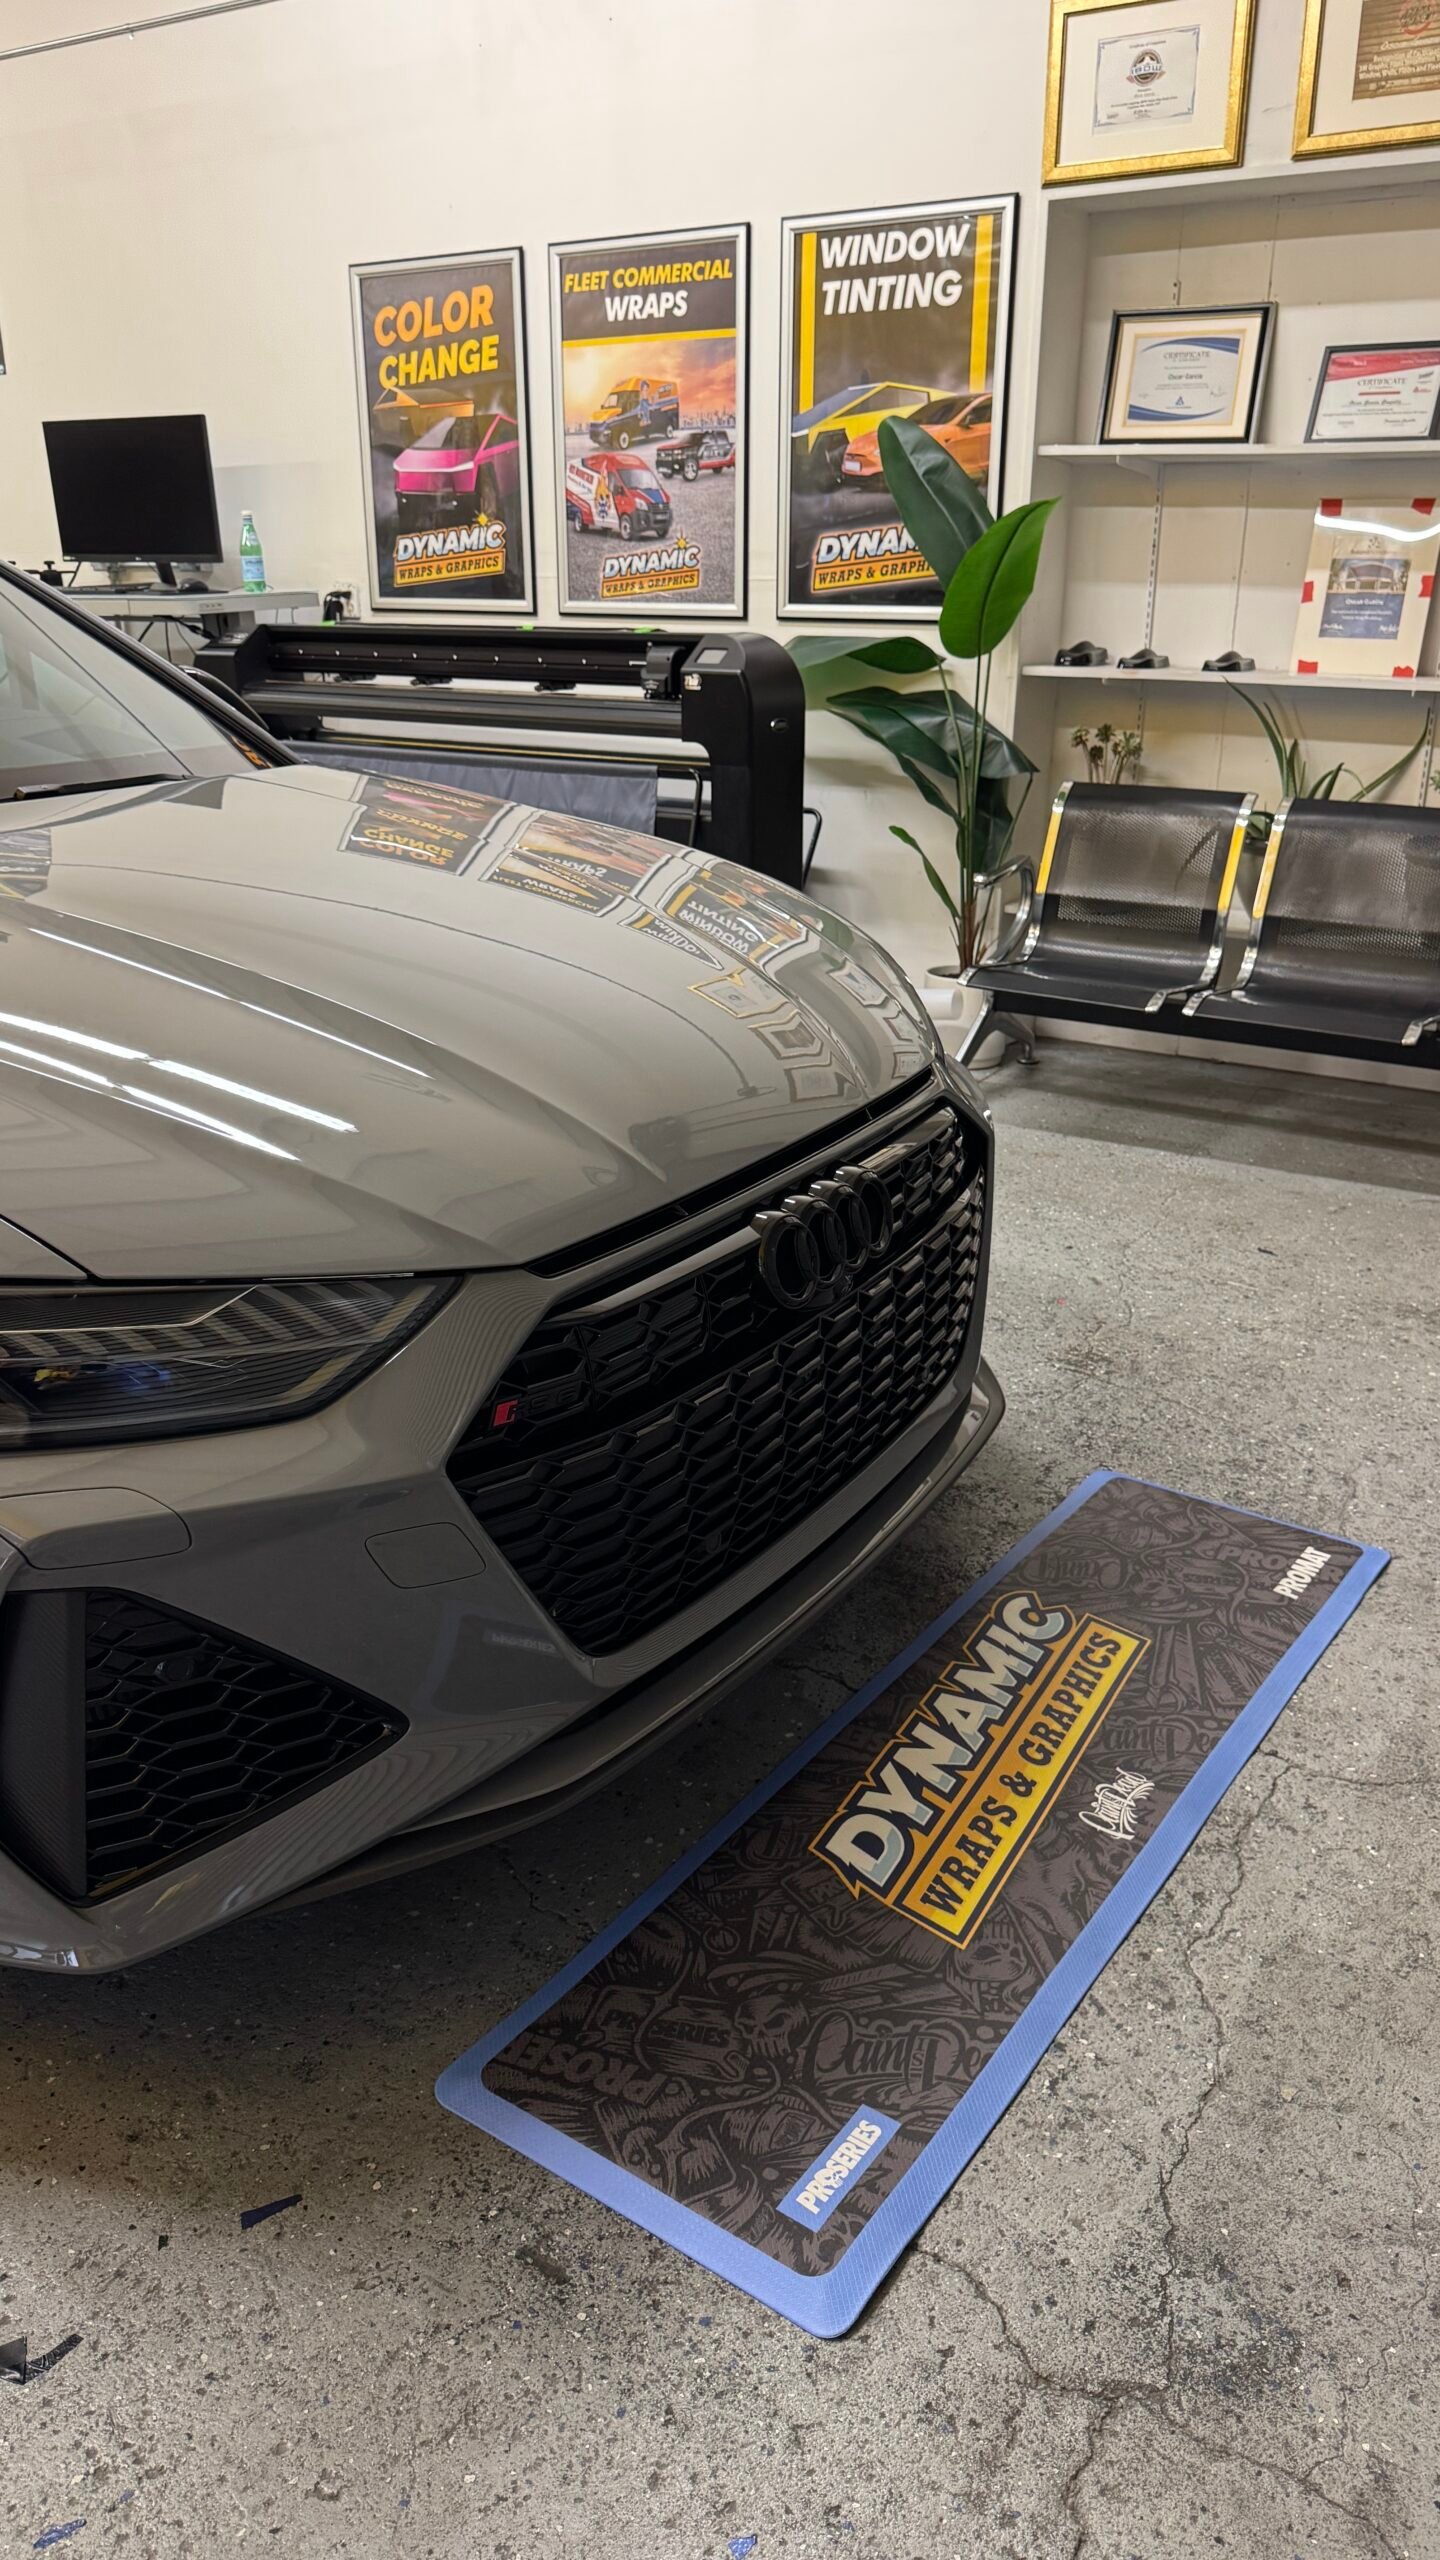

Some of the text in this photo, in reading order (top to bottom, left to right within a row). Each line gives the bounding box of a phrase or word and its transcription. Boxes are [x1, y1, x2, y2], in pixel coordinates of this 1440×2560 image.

[820, 224, 970, 269] WINDOW
[564, 259, 732, 293] FLEET COMMERCIAL
[822, 270, 962, 315] TINTING
[374, 285, 494, 347] COLOR
[605, 290, 688, 322] WRAPS
[379, 335, 499, 389] CHANGE
[398, 523, 503, 561] DYNAMIC
[604, 547, 700, 578] DYNAMIC
[817, 527, 919, 563] DYNAM
[400, 556, 500, 580] WRAPS & GRAPHICS
[605, 581, 636, 593] WRAPS
[648, 574, 695, 588] GRAPHICS
[819, 561, 931, 585] WRAPS & GRAPH
[1273, 1546, 1331, 1600] PROMAT
[825, 1597, 1065, 1887] DYNAMIC
[920, 1632, 1121, 1917] WRAPS & GRAPHICS
[795, 2120, 882, 2215] PROSERIES
